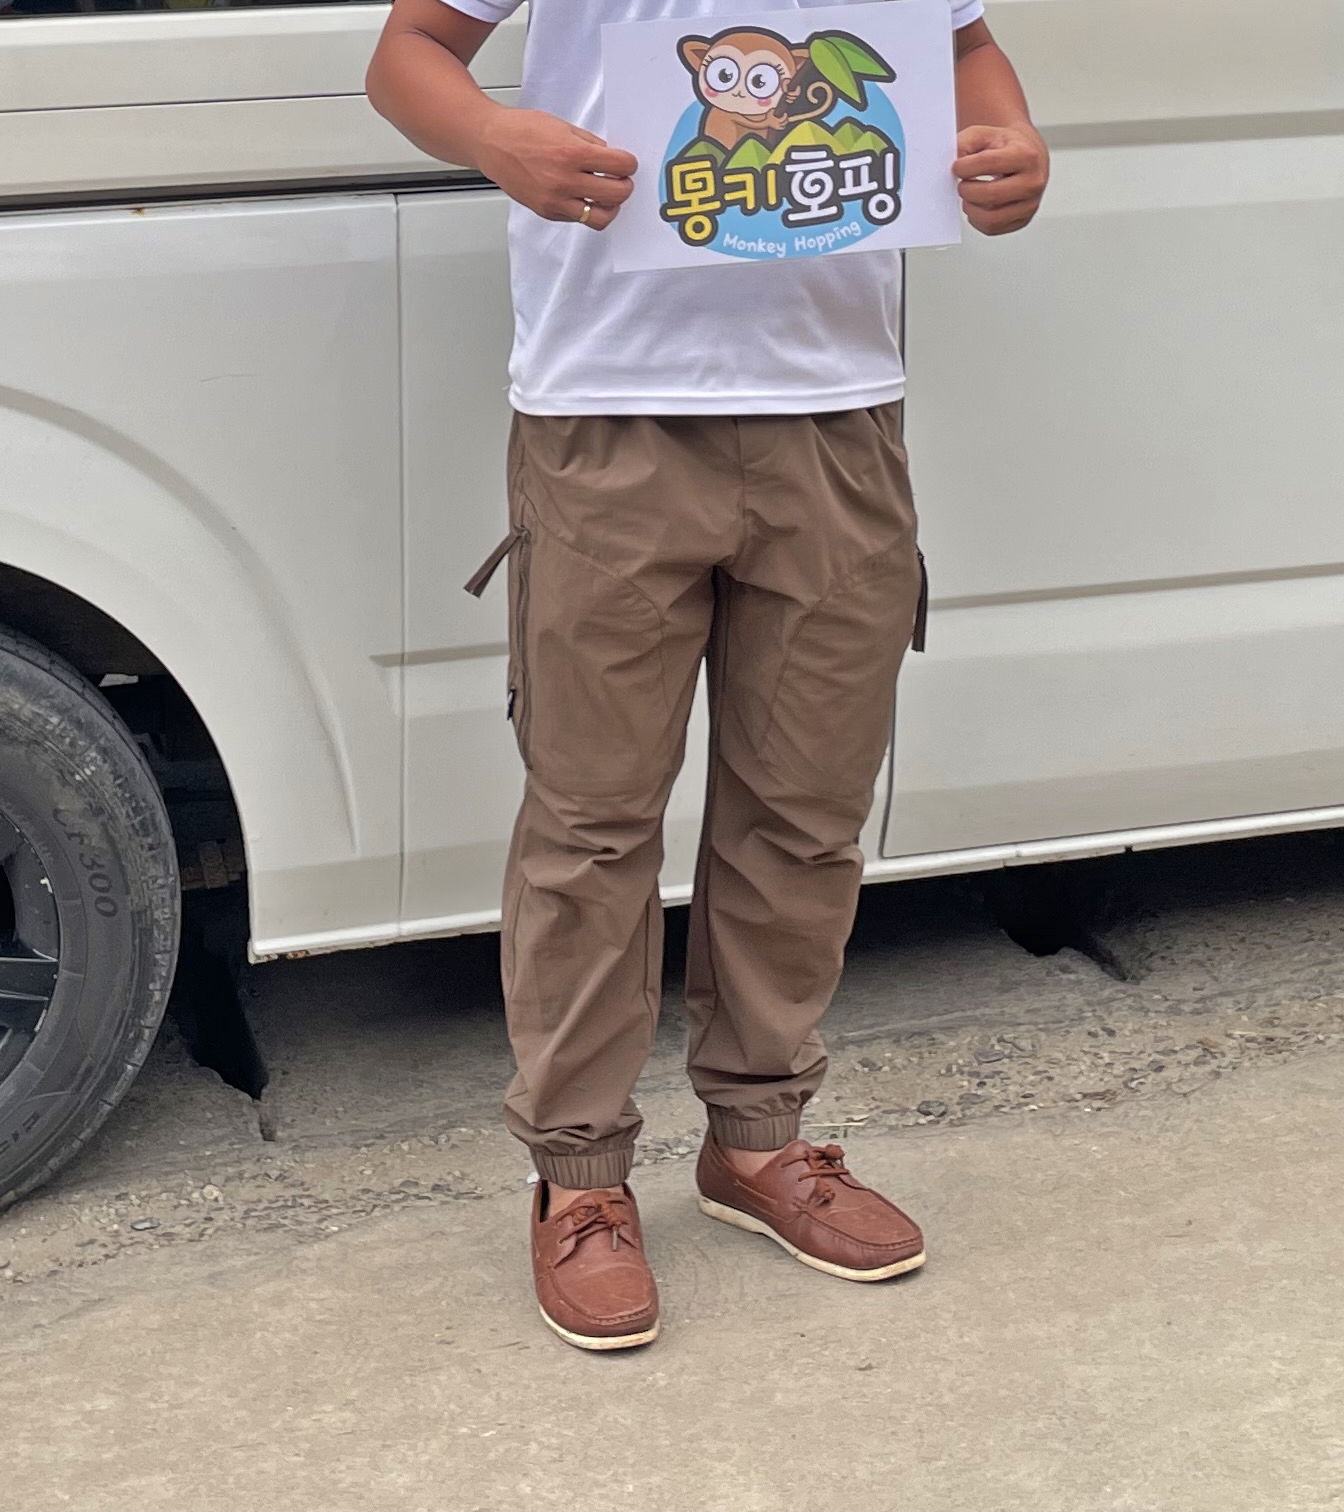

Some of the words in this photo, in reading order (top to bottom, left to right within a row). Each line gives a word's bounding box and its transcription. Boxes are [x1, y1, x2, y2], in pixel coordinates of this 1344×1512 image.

[663, 146, 901, 246] 몽키호핑
[722, 231, 787, 257] Monkey
[794, 219, 862, 252] Hopping
